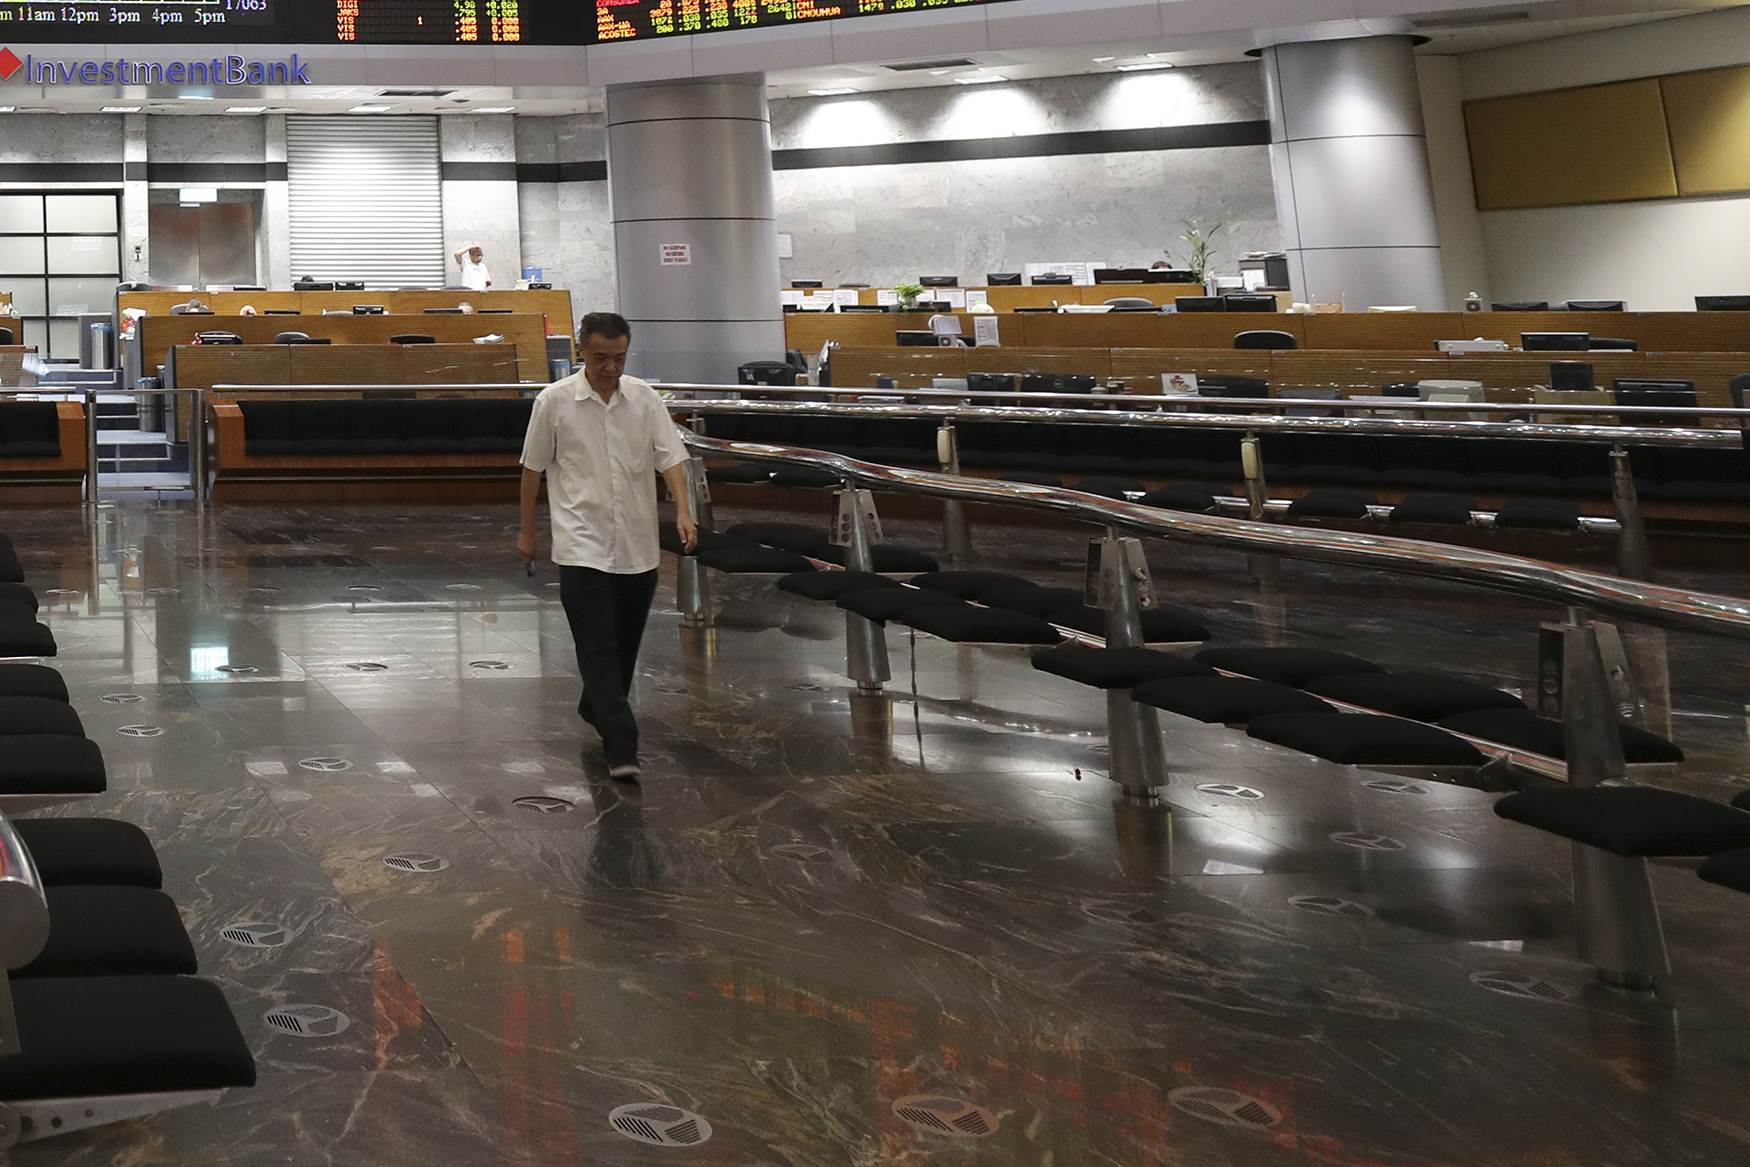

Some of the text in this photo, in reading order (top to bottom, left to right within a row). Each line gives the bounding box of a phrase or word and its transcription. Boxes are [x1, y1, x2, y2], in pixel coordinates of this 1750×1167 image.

[18, 8, 56, 22] 11am
[61, 9, 100, 25] 12pm
[109, 9, 141, 25] 3pm
[152, 9, 183, 25] 4pm
[193, 9, 226, 25] 5pm
[337, 9, 359, 17] JAKS
[26, 54, 311, 85] InvestmentBank
